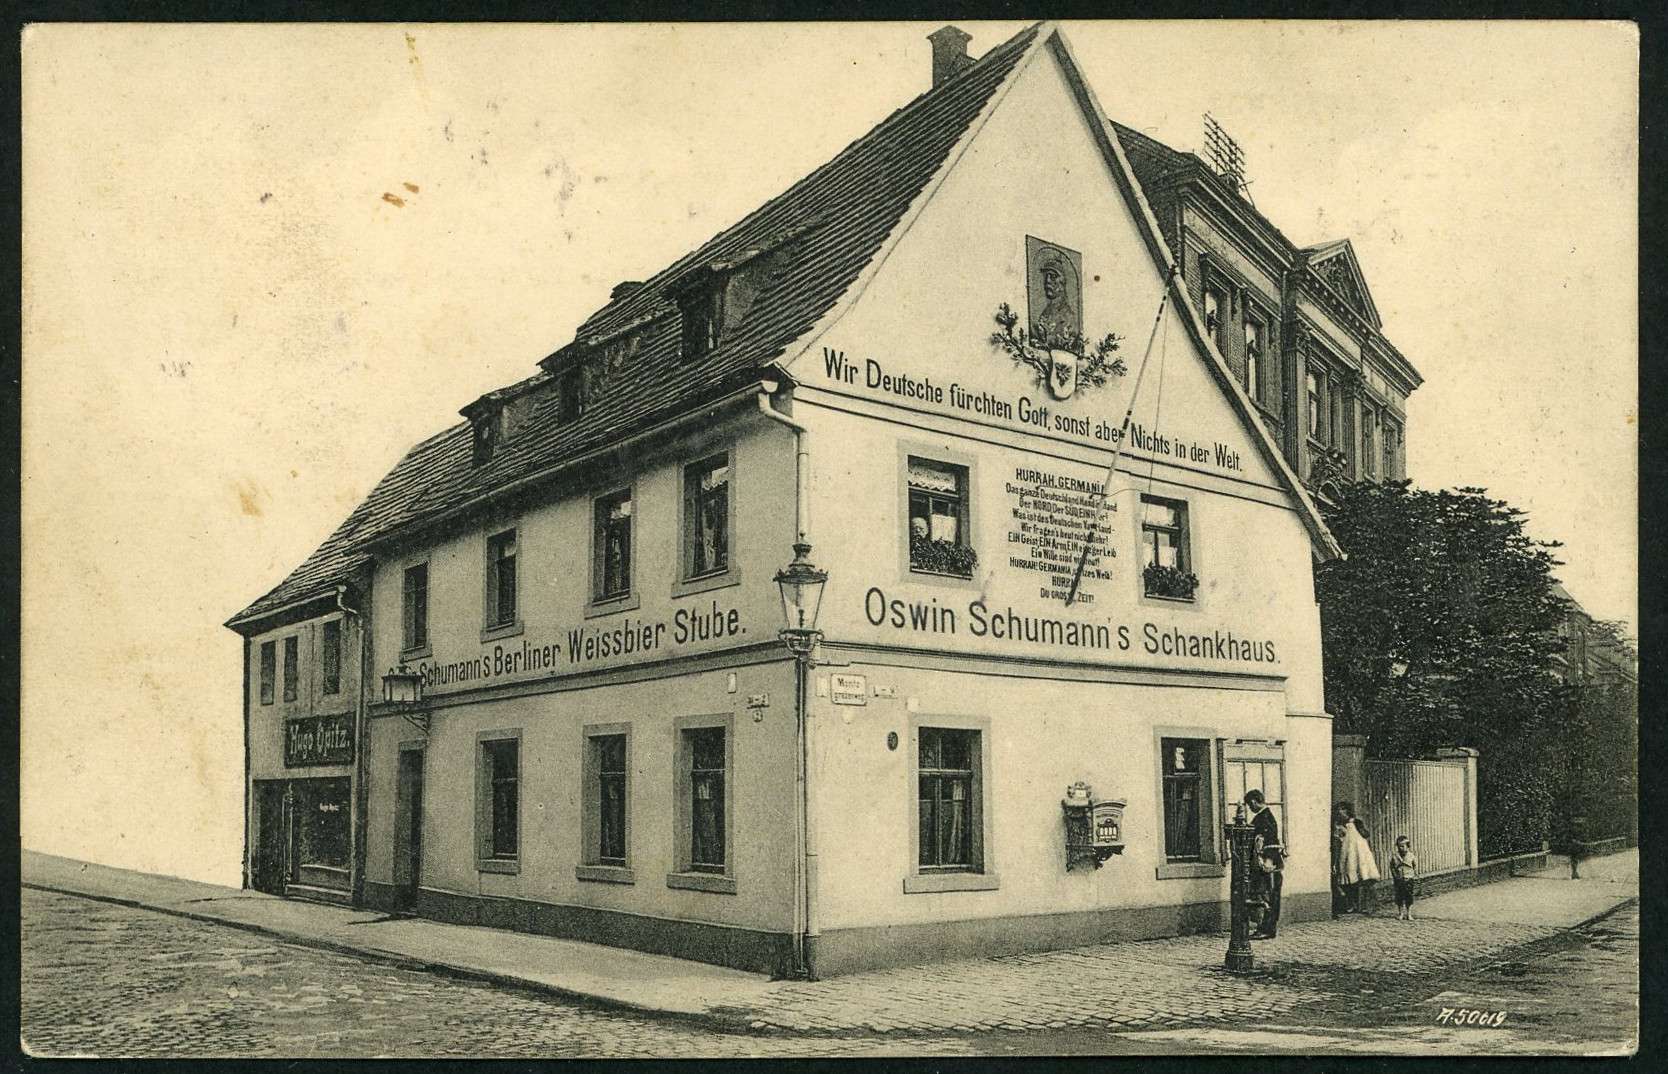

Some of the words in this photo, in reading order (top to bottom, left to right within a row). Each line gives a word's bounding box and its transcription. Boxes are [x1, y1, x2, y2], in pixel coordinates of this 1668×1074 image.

[823, 348, 859, 384] Wir
[866, 360, 943, 403] Deutsche
[950, 384, 1013, 419] fürchten
[1018, 398, 1052, 432] Gott,
[1055, 415, 1091, 438] sonst
[1095, 421, 1125, 443] aber
[1131, 423, 1170, 455] Nichts
[1175, 439, 1186, 457] in
[1190, 442, 1209, 463] der
[1214, 443, 1242, 472] Welt.
[1006, 483, 1019, 494] Das
[1041, 489, 1079, 505] Deutschland
[1019, 497, 1031, 509] Der
[1013, 509, 1026, 520] Was
[1037, 513, 1049, 523] des
[1050, 514, 1082, 530] Deutschen
[1021, 523, 1033, 534] Wir
[1008, 532, 1020, 543] EIN
[1039, 537, 1050, 547] EIN
[1067, 541, 1078, 551] EIN
[1043, 550, 1058, 562] Wille
[1059, 553, 1072, 563] sind
[865, 587, 955, 634] Oswin
[969, 602, 1130, 651] Schumann's
[1144, 623, 1281, 664] Schankhaus.
[419, 655, 490, 688] Schumann's
[494, 642, 560, 677] Berliner
[568, 620, 665, 663] Weissbier
[674, 600, 746, 644] Stube.
[290, 724, 314, 759] Hugo
[317, 722, 350, 757] Opitz.
